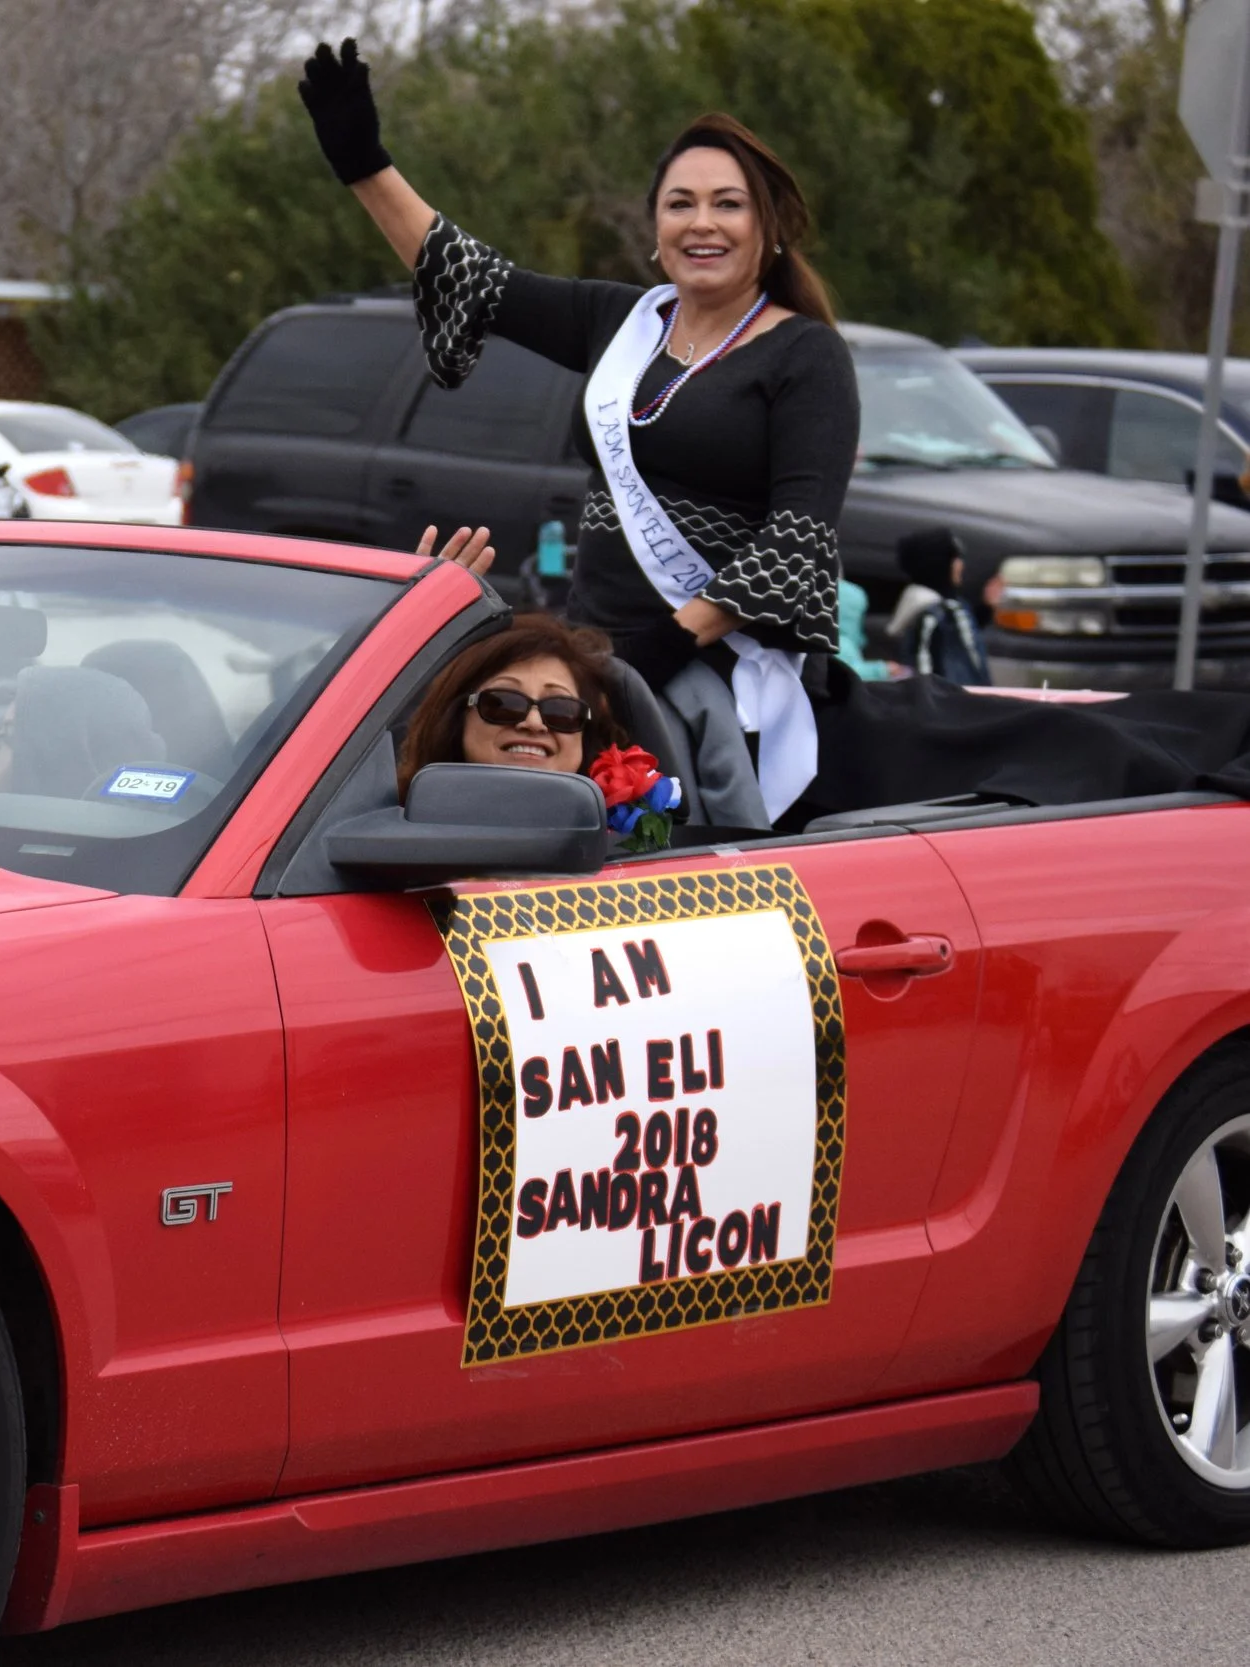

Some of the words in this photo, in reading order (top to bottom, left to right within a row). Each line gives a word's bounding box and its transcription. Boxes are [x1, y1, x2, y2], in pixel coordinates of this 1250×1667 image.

[598, 398, 618, 413] I
[597, 418, 626, 463] AM
[616, 465, 653, 518] SAN
[641, 517, 685, 567] ELI
[518, 962, 545, 1021] I
[590, 938, 672, 1008] AM
[520, 1038, 626, 1119] SAN
[646, 1029, 724, 1102] ELI
[613, 1107, 719, 1173] 2018
[161, 1181, 234, 1226] GT
[516, 1163, 702, 1239] SANDRA
[638, 1201, 781, 1285] LICON
